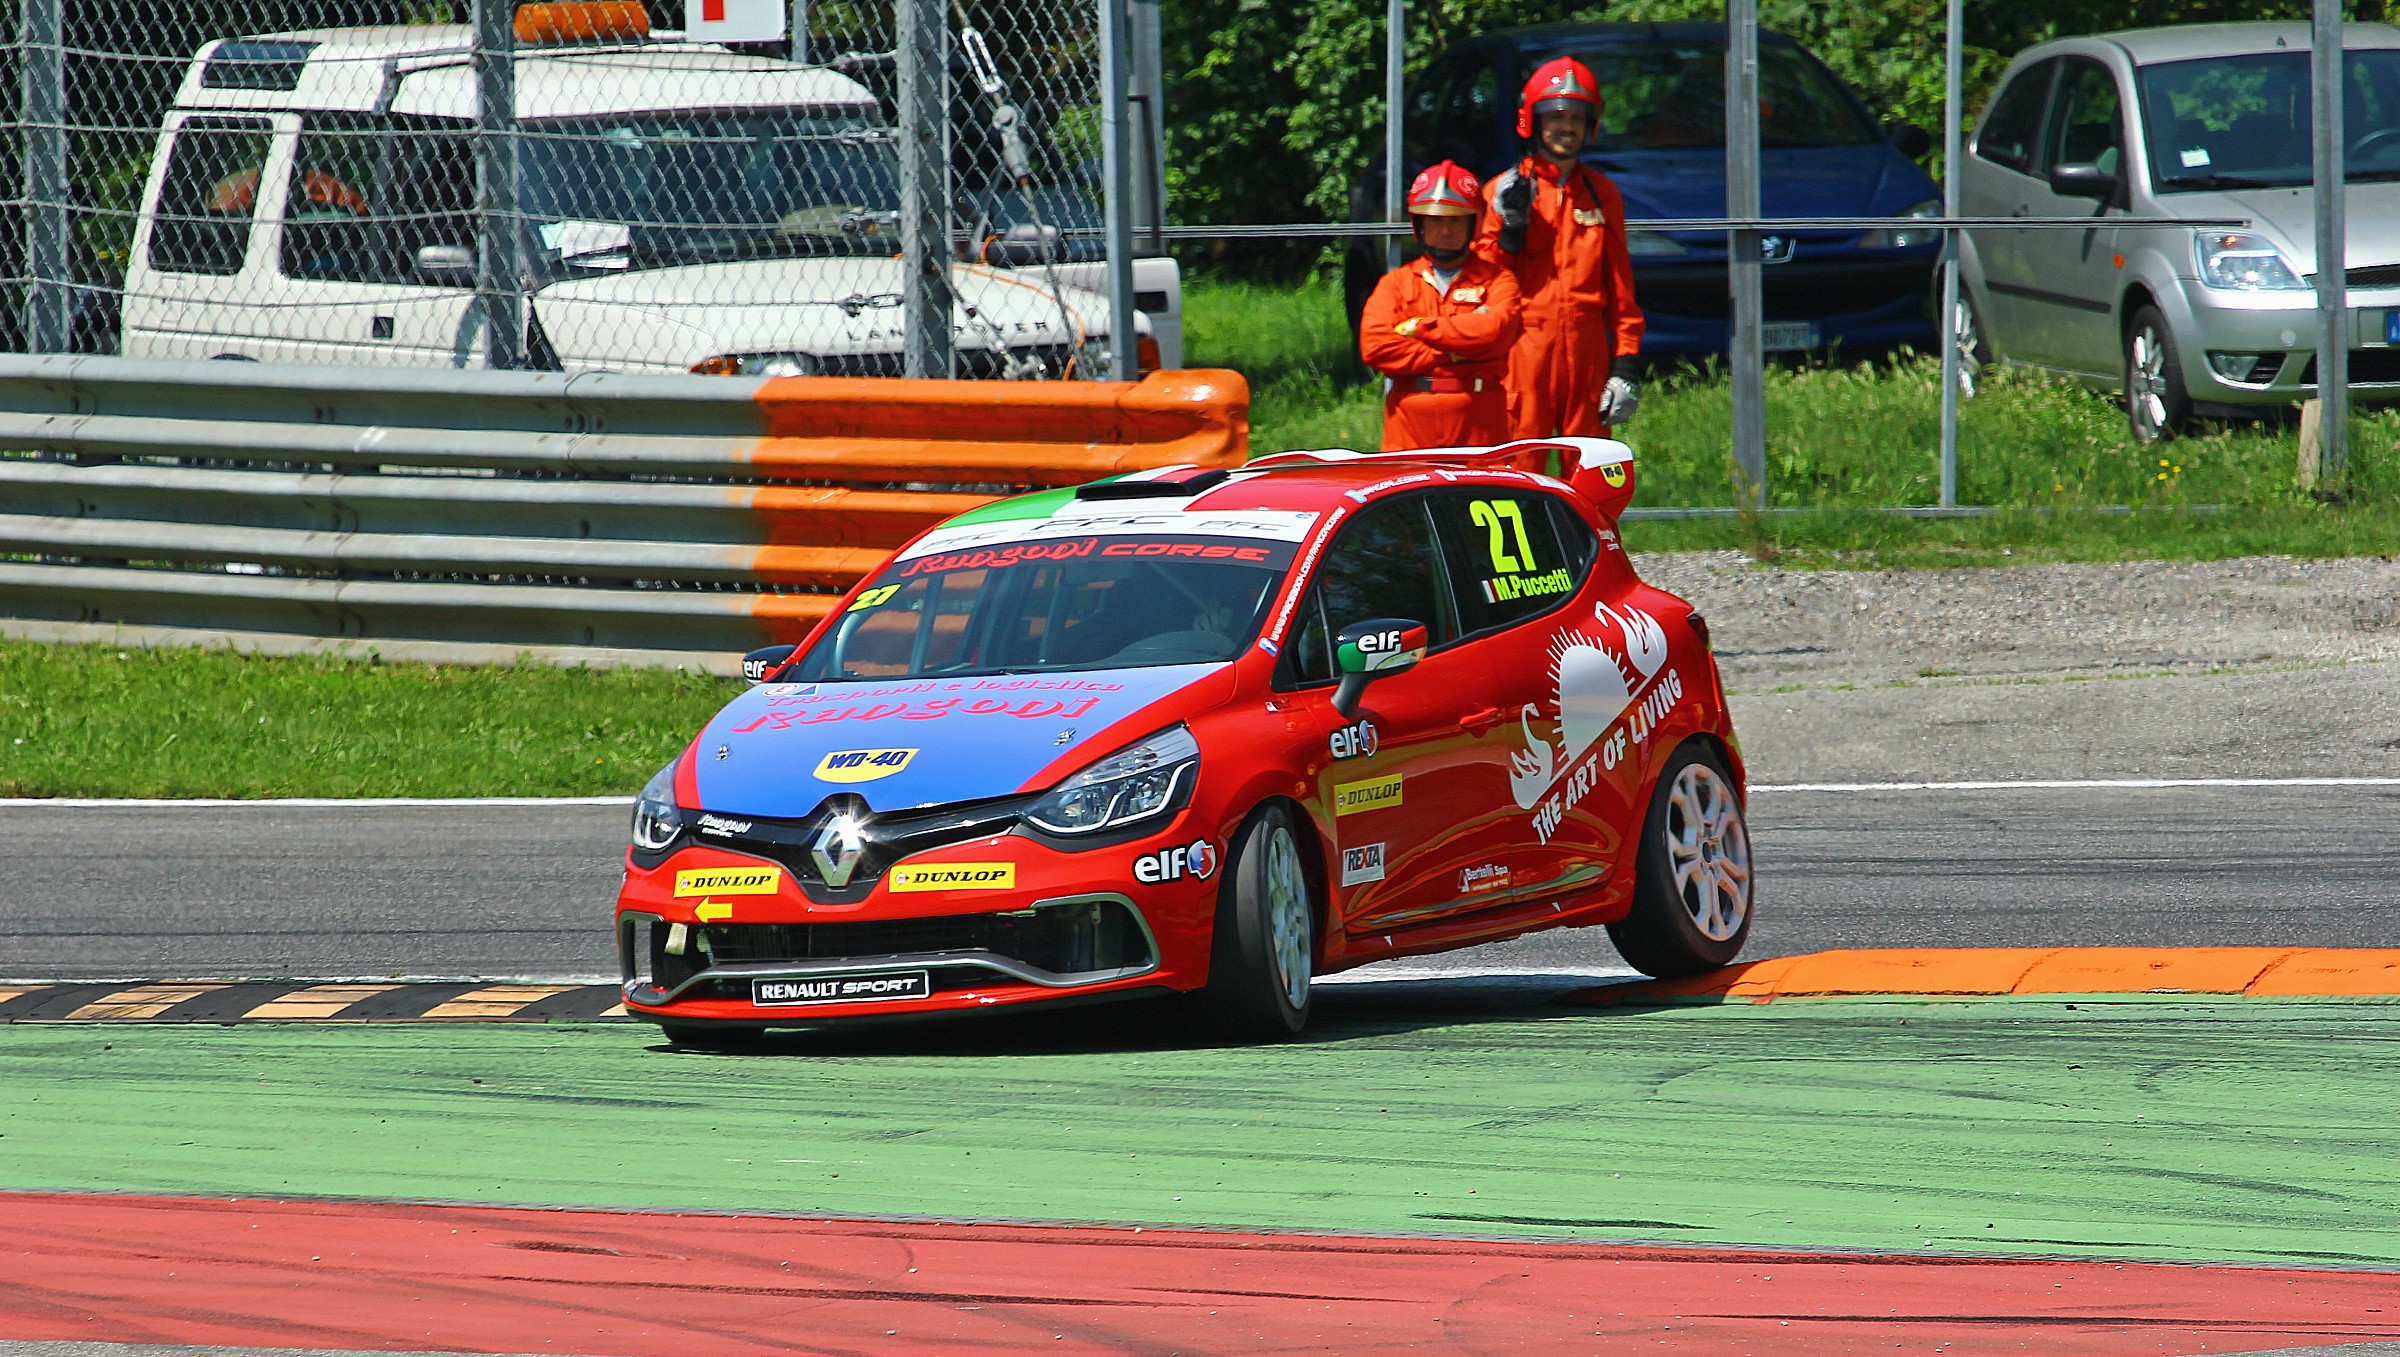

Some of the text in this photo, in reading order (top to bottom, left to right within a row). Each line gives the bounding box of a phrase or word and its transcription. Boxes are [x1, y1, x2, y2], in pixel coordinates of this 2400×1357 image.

[1469, 500, 1537, 573] 27
[1102, 543, 1271, 561] CORSE
[1492, 568, 1574, 601] M.Puccetti
[847, 585, 902, 612] 27
[1358, 630, 1401, 652] elf
[743, 660, 767, 678] elf
[1330, 726, 1359, 758] elf
[827, 751, 907, 770] WD-40
[1532, 668, 1683, 846] THE ART OF LIVING
[1347, 782, 1401, 806] DUNLOP
[1134, 847, 1186, 882] elf
[692, 876, 771, 889] DUNLOP
[912, 870, 1007, 883] DUNLOP
[760, 978, 918, 999] RENAULT SPORT
